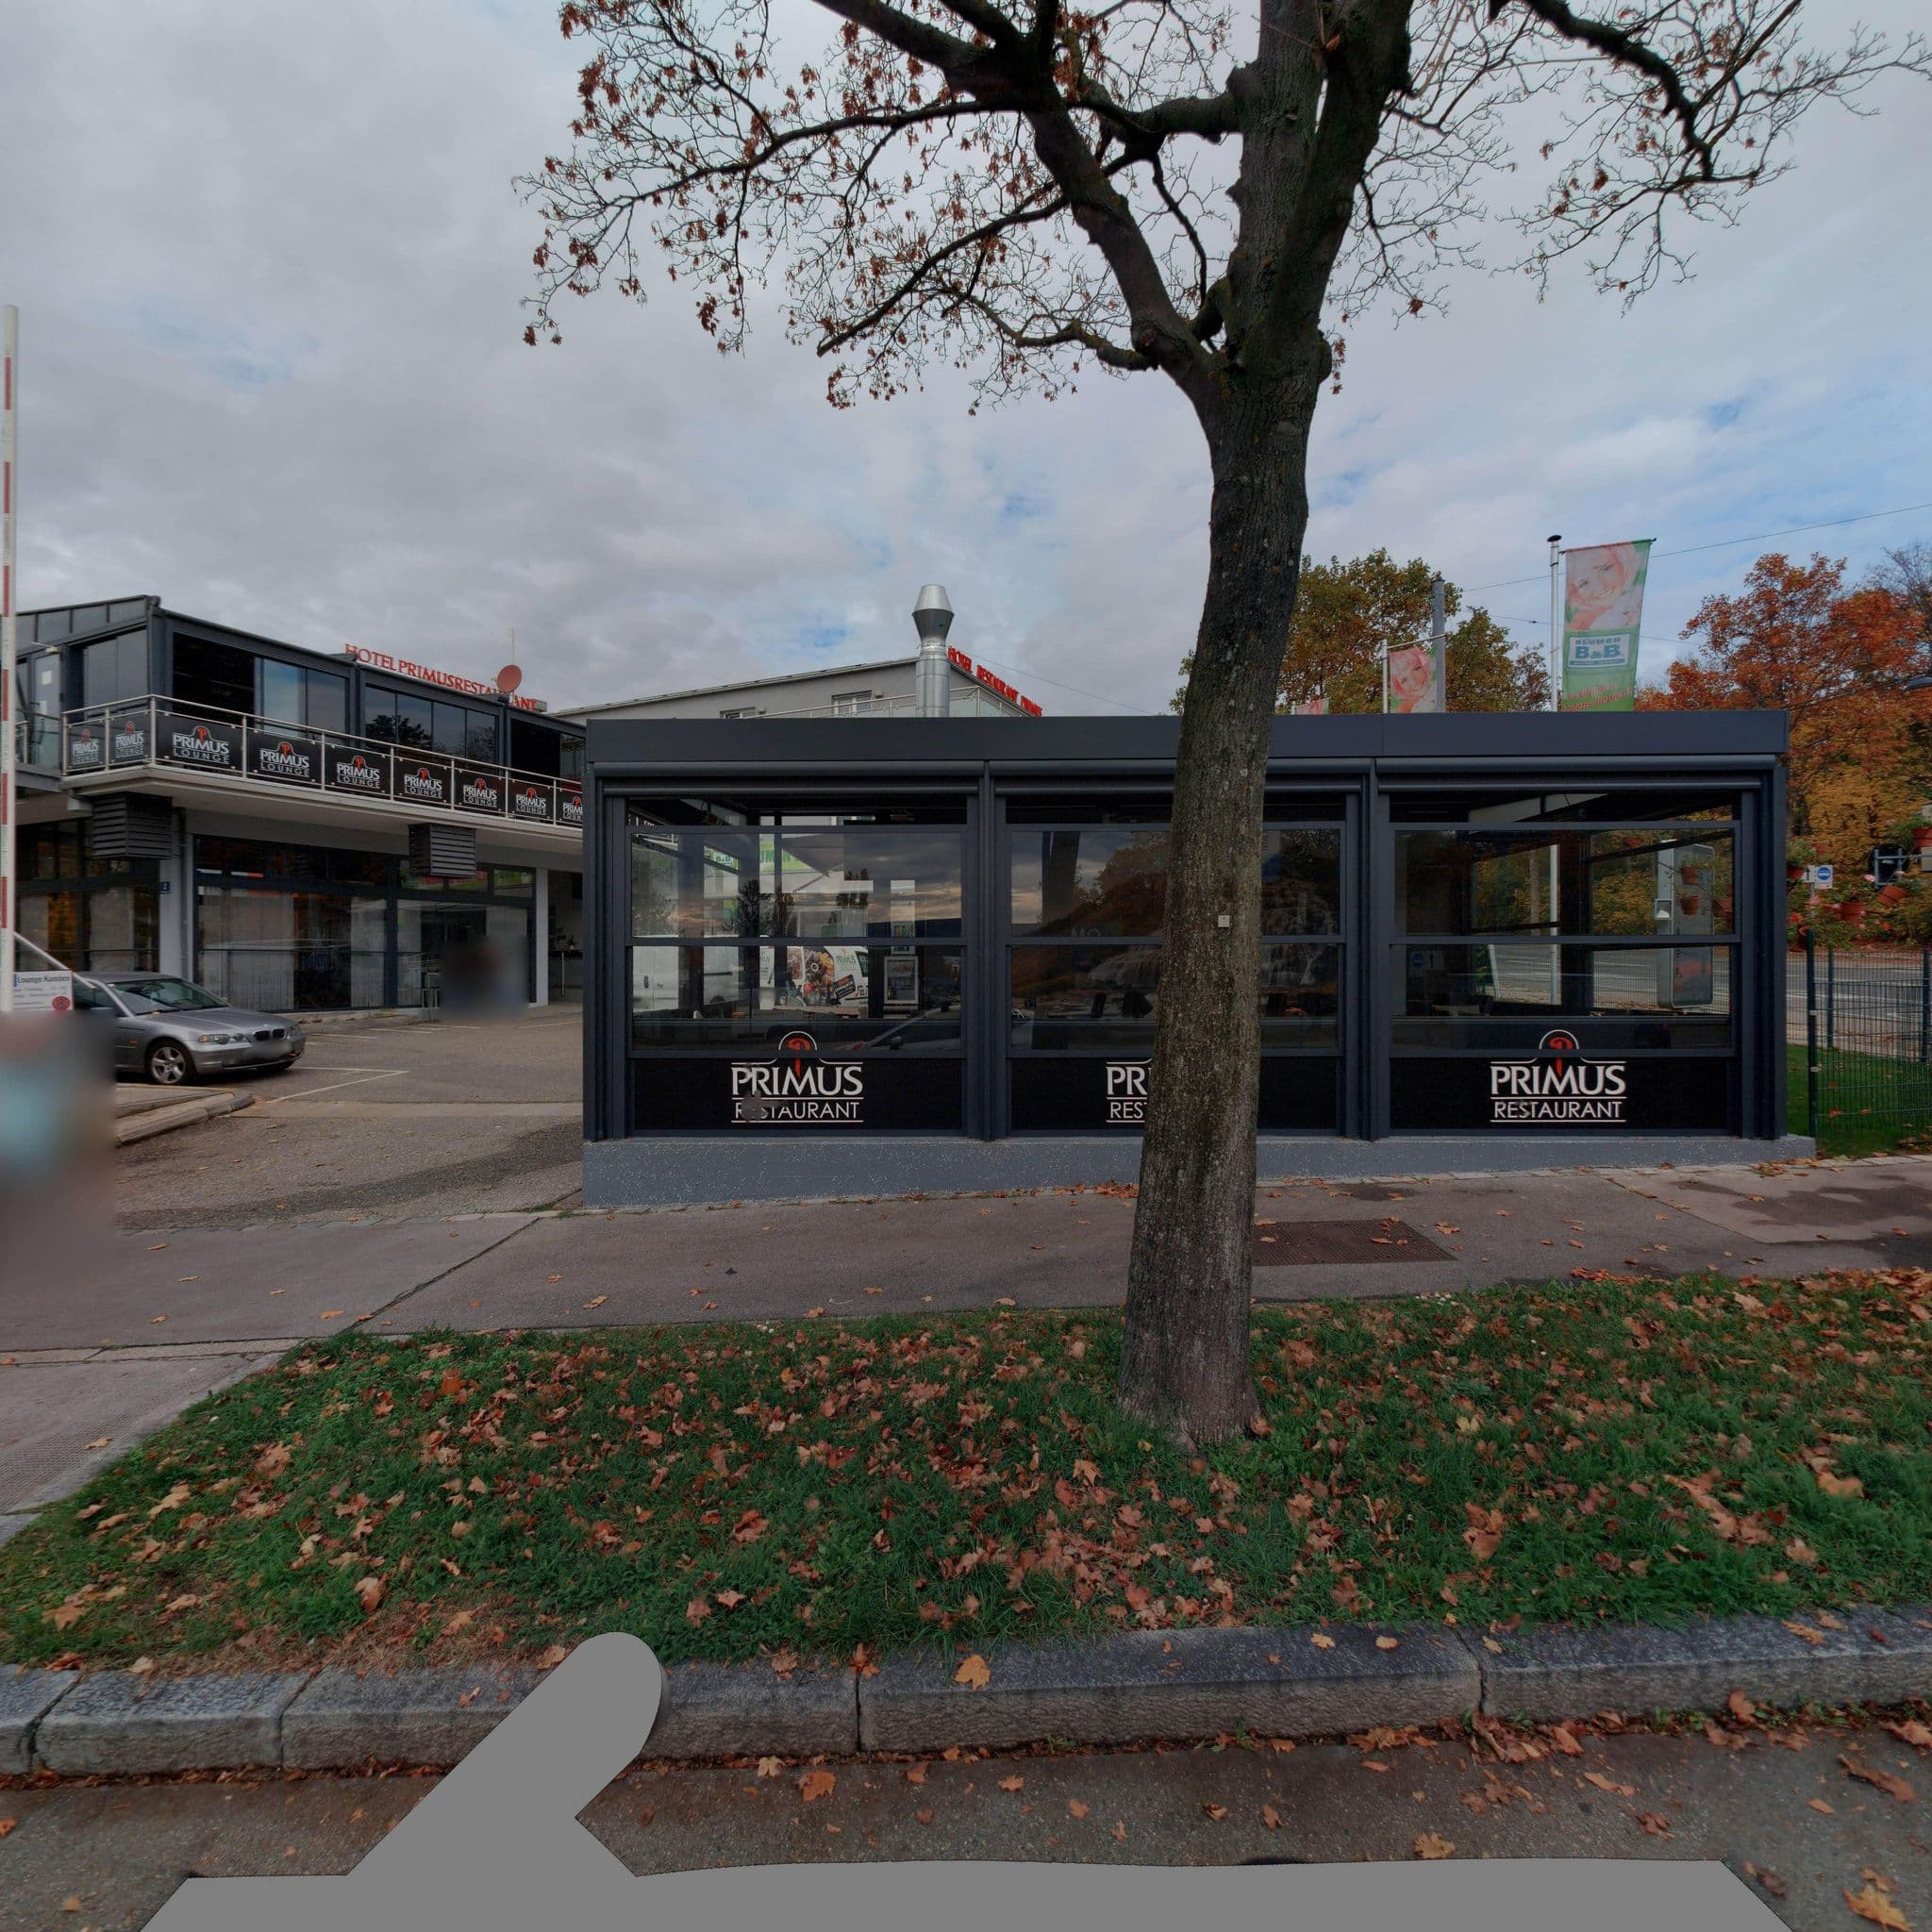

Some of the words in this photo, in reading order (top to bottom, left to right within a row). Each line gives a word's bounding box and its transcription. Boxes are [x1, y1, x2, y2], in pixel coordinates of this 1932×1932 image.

[345, 643, 396, 672] HOTEL
[1574, 644, 1621, 659] B&B
[115, 733, 143, 748] PRIMUS
[173, 734, 229, 755] PRIMUS
[174, 748, 229, 765] LOUNGE
[259, 749, 309, 769] PRIMUS
[260, 762, 309, 778] LOUNGE
[337, 764, 380, 780] PRIMUS
[337, 774, 380, 789] LOUNGE
[404, 775, 442, 791] PRIMUS
[405, 786, 442, 800] LOUNGE
[462, 785, 498, 800] PRIMUS
[463, 795, 498, 808] LOUNGE
[516, 794, 547, 808] PRIMUS
[731, 1065, 864, 1096] PRIMUS
[1490, 1064, 1627, 1095] PRIMUS
[1494, 1101, 1624, 1119] RESTAURANT
